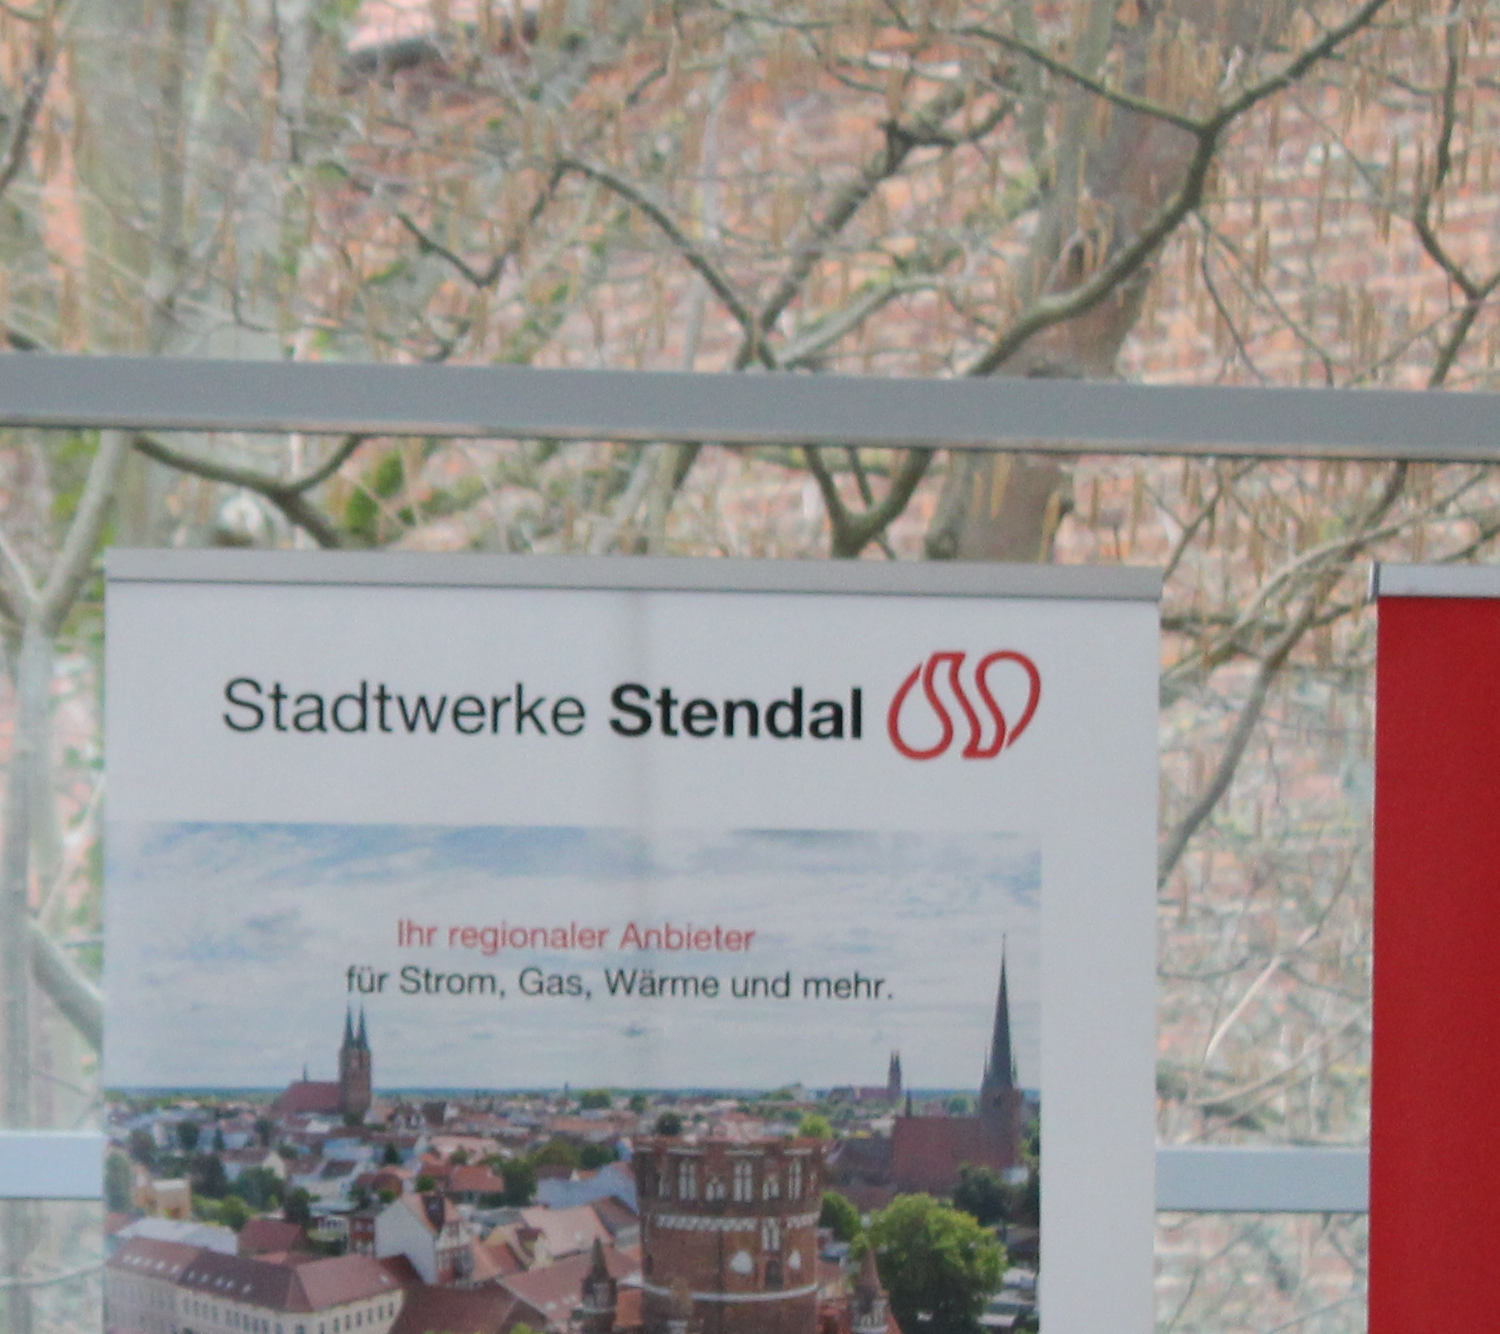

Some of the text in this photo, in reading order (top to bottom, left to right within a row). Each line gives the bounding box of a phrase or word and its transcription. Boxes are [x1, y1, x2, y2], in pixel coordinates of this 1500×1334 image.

[222, 676, 864, 741] Stadtwerke Stendal
[397, 917, 755, 955] Ihr regionaler Anbieter
[346, 965, 894, 1002] für Strom, Gas, Wärme und mehr.
